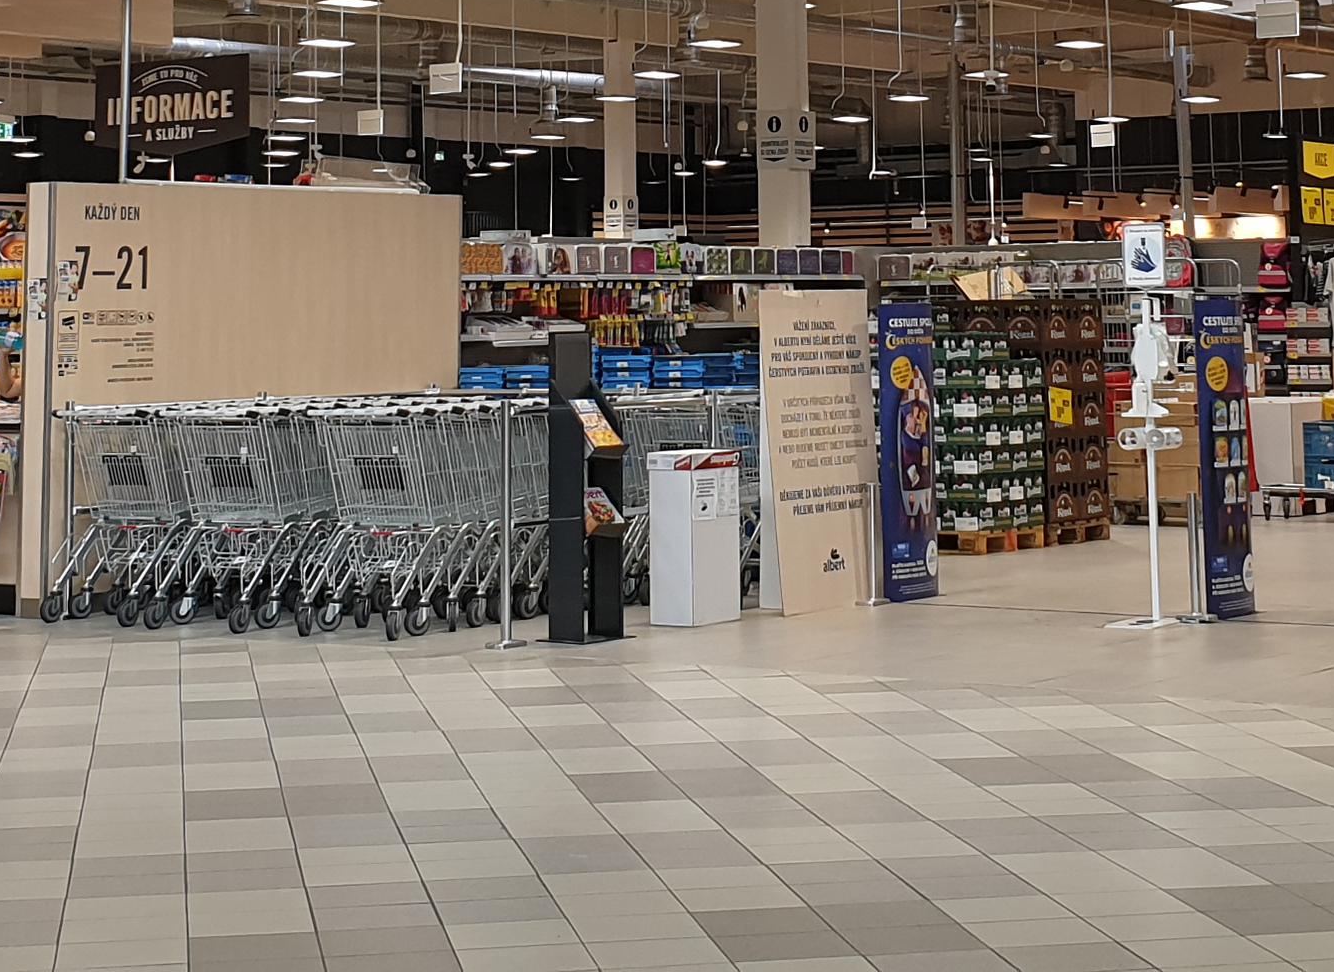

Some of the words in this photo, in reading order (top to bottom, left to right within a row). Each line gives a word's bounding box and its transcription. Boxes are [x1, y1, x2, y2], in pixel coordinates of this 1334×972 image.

[107, 89, 234, 126] IFORMACE
[145, 129, 153, 142] A
[155, 124, 195, 141] SLUŽBY
[84, 203, 117, 220] KAŽDÝ
[120, 206, 140, 220] DEN
[823, 557, 845, 572] albert
